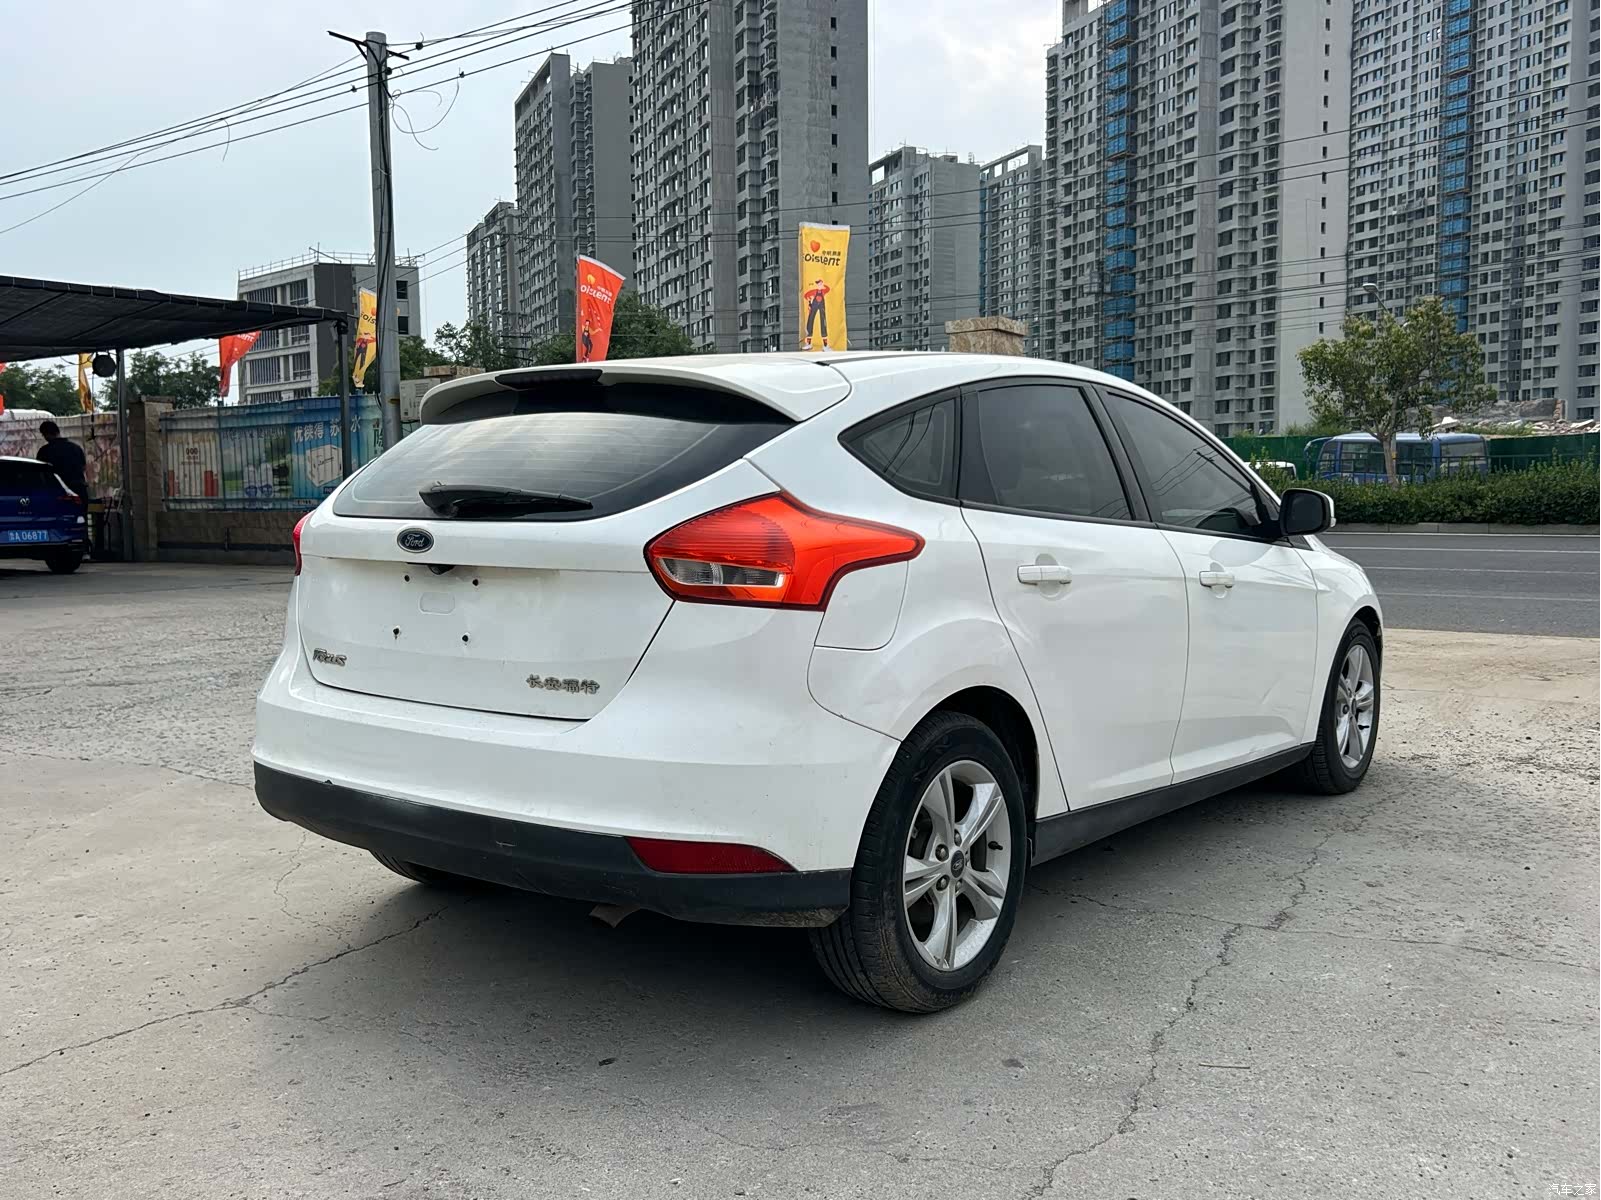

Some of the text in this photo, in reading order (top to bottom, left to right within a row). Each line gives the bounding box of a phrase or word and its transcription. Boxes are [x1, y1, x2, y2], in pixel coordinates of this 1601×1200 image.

[405, 533, 425, 547] Ford
[525, 673, 601, 695] 长安福特
